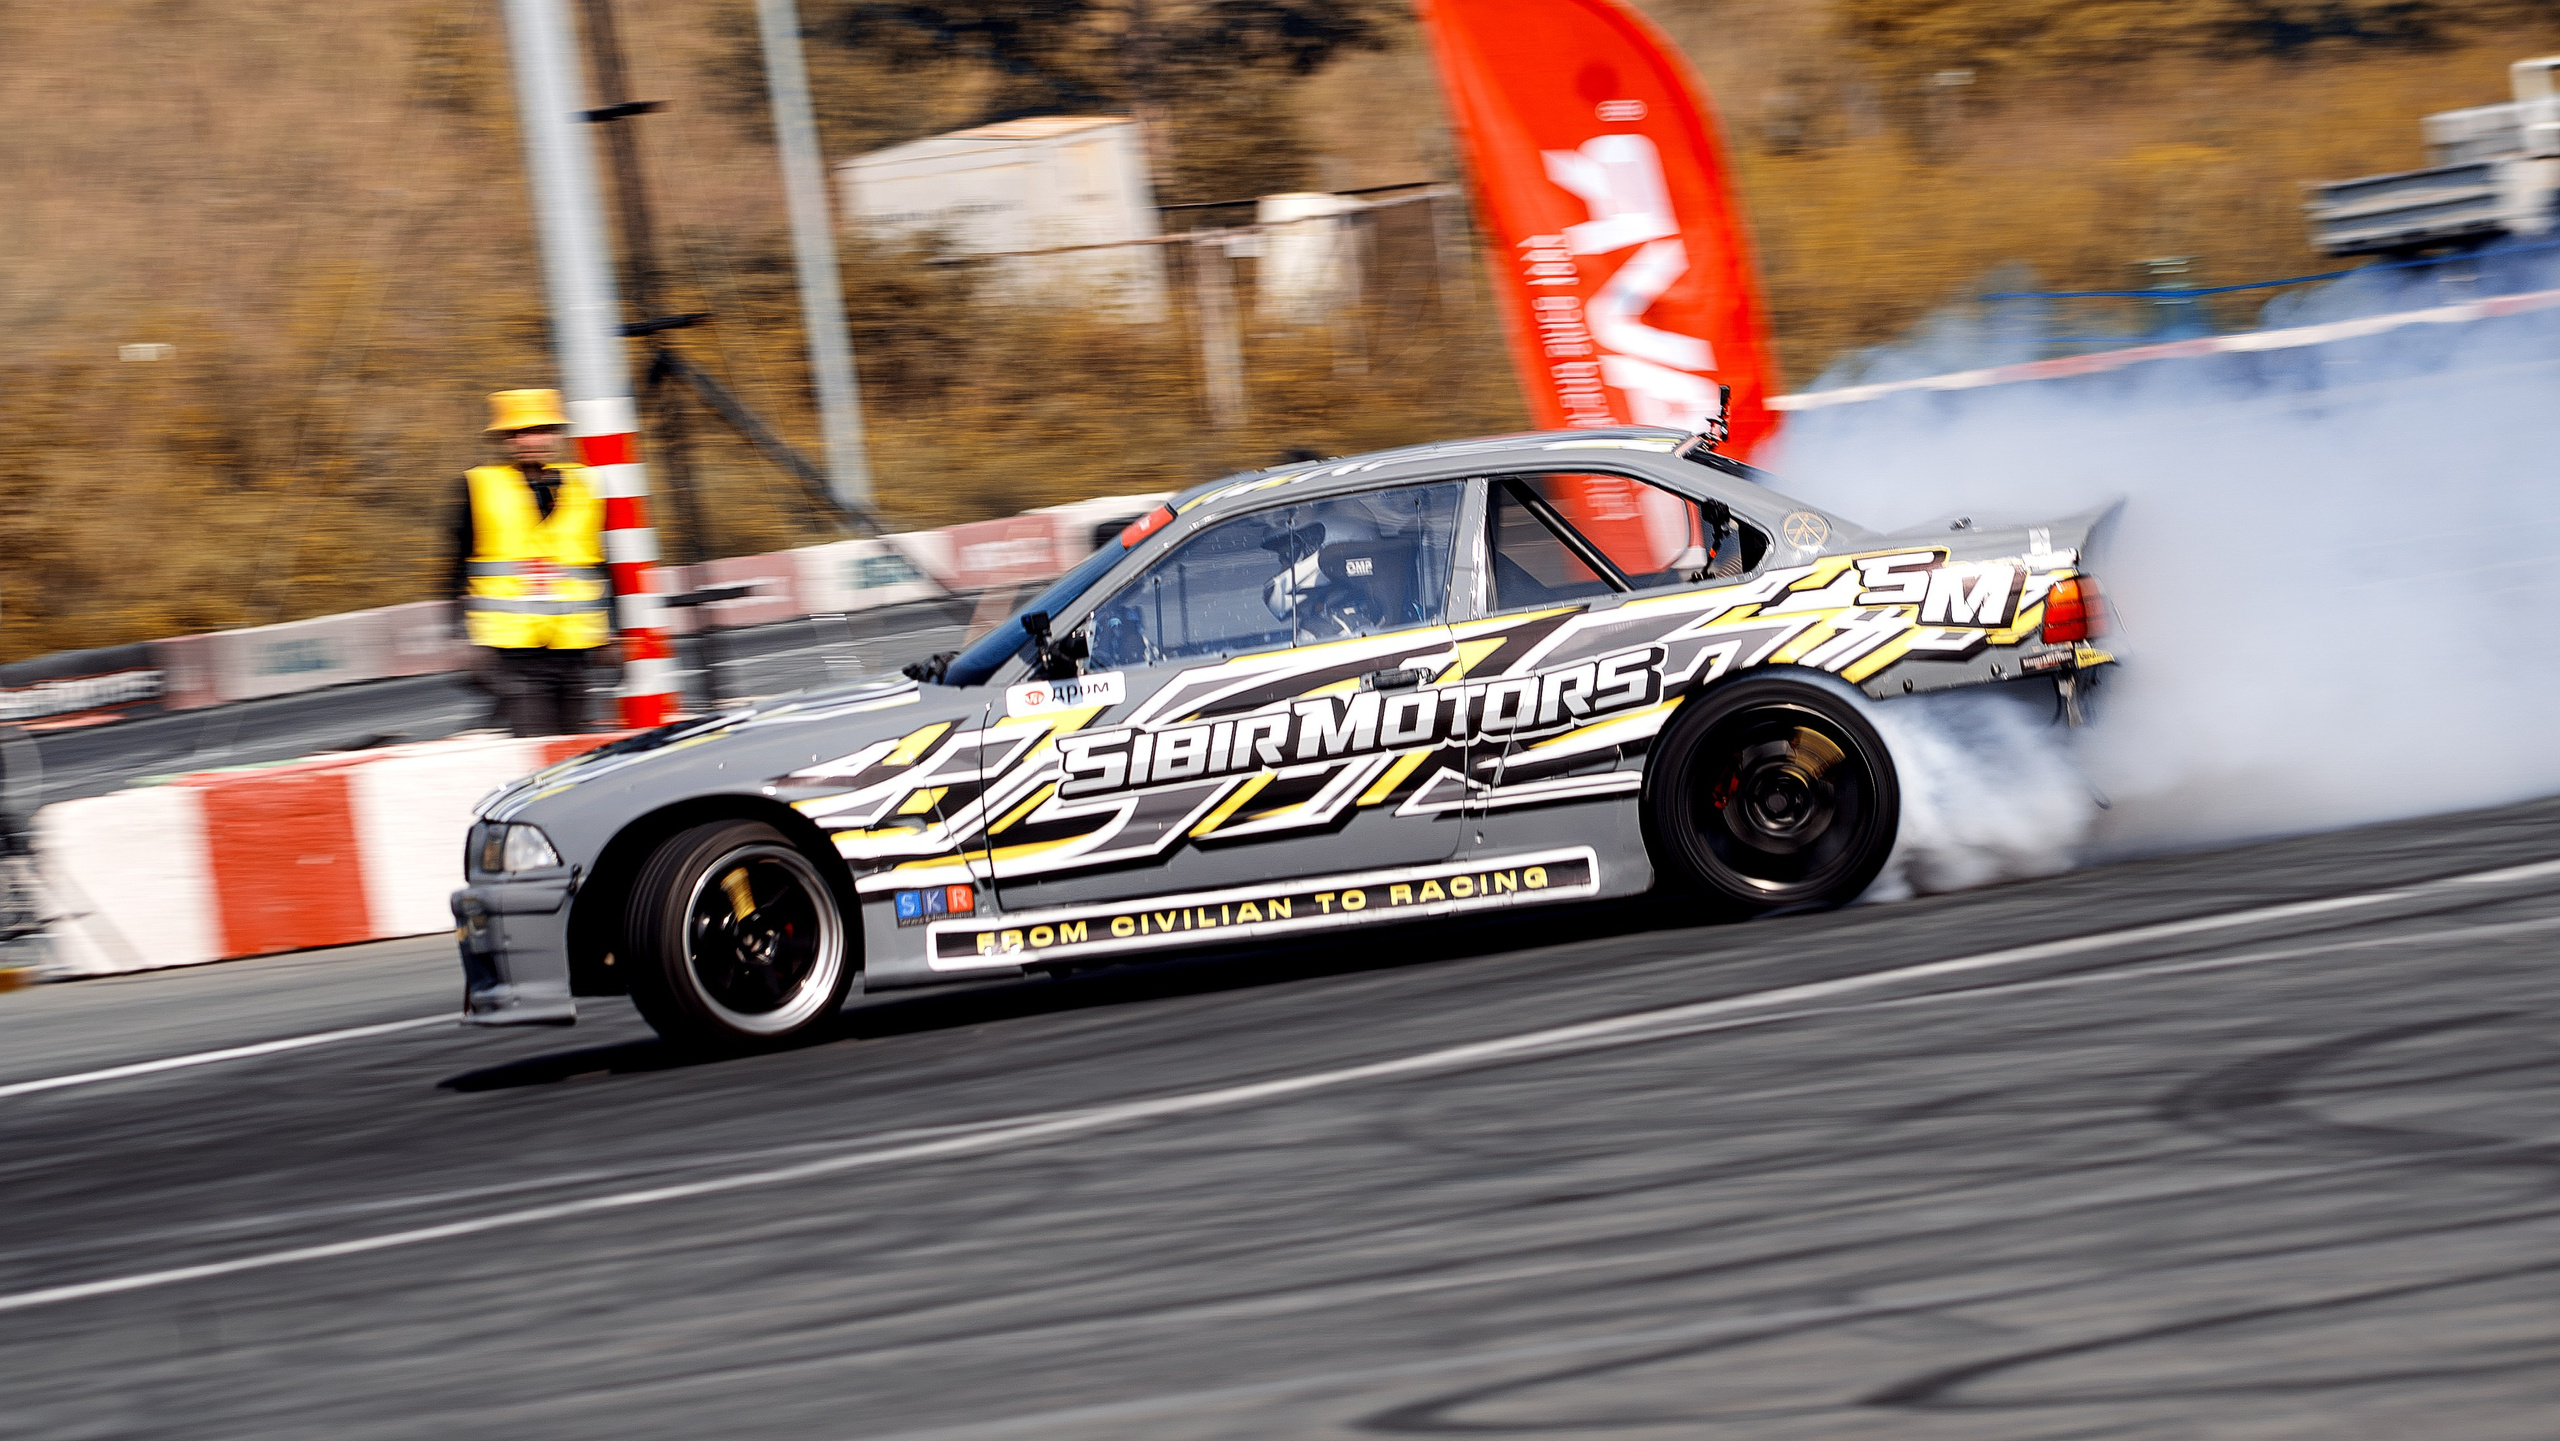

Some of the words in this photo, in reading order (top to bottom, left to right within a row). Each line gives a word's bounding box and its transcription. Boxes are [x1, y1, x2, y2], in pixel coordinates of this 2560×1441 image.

[1346, 560, 1373, 575] OMP
[1856, 551, 2016, 624] SM
[901, 887, 969, 917] SKR
[975, 920, 1089, 955] FROM
[1110, 896, 1292, 938] CIVILIAN
[1314, 888, 1368, 914] TO
[1388, 866, 1550, 906] RACING
